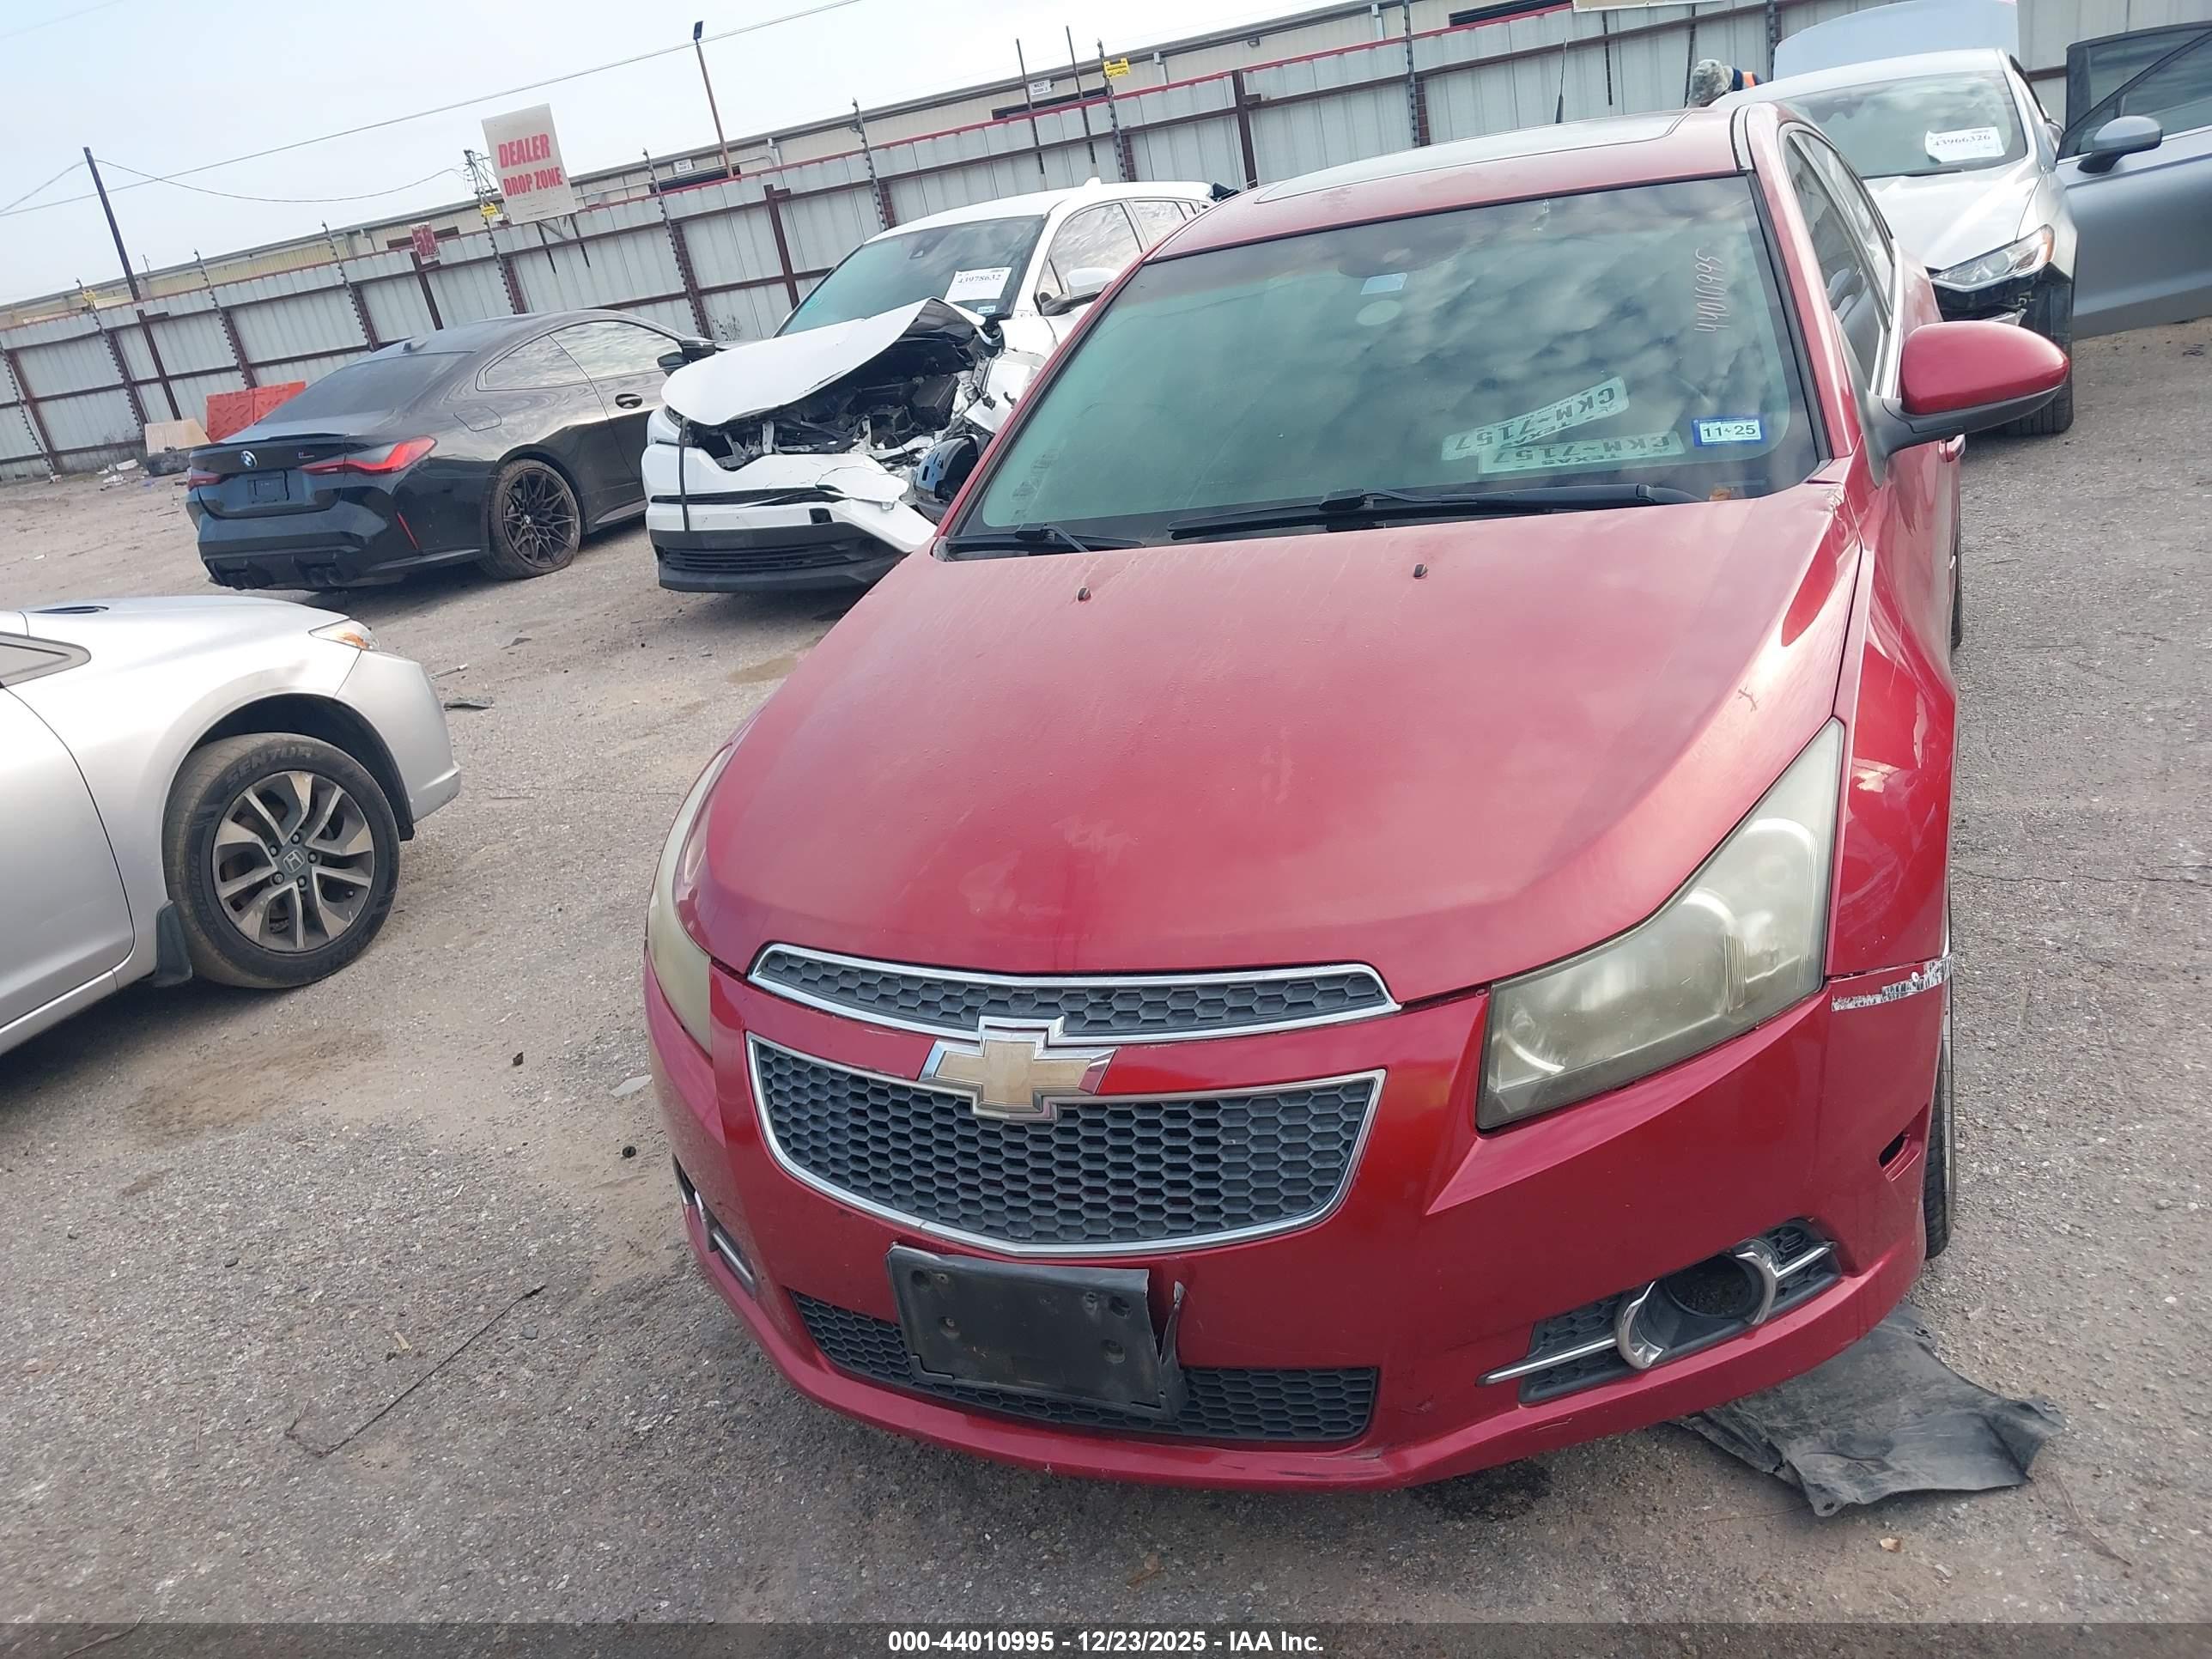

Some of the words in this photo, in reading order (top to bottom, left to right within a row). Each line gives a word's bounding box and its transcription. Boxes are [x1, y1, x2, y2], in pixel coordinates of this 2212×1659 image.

[498, 133, 550, 168] DEALER
[502, 173, 532, 197] DROP
[533, 167, 563, 190] ZONE
[1693, 247, 1730, 331] 44010995
[1541, 453, 1620, 465] TEXAS
